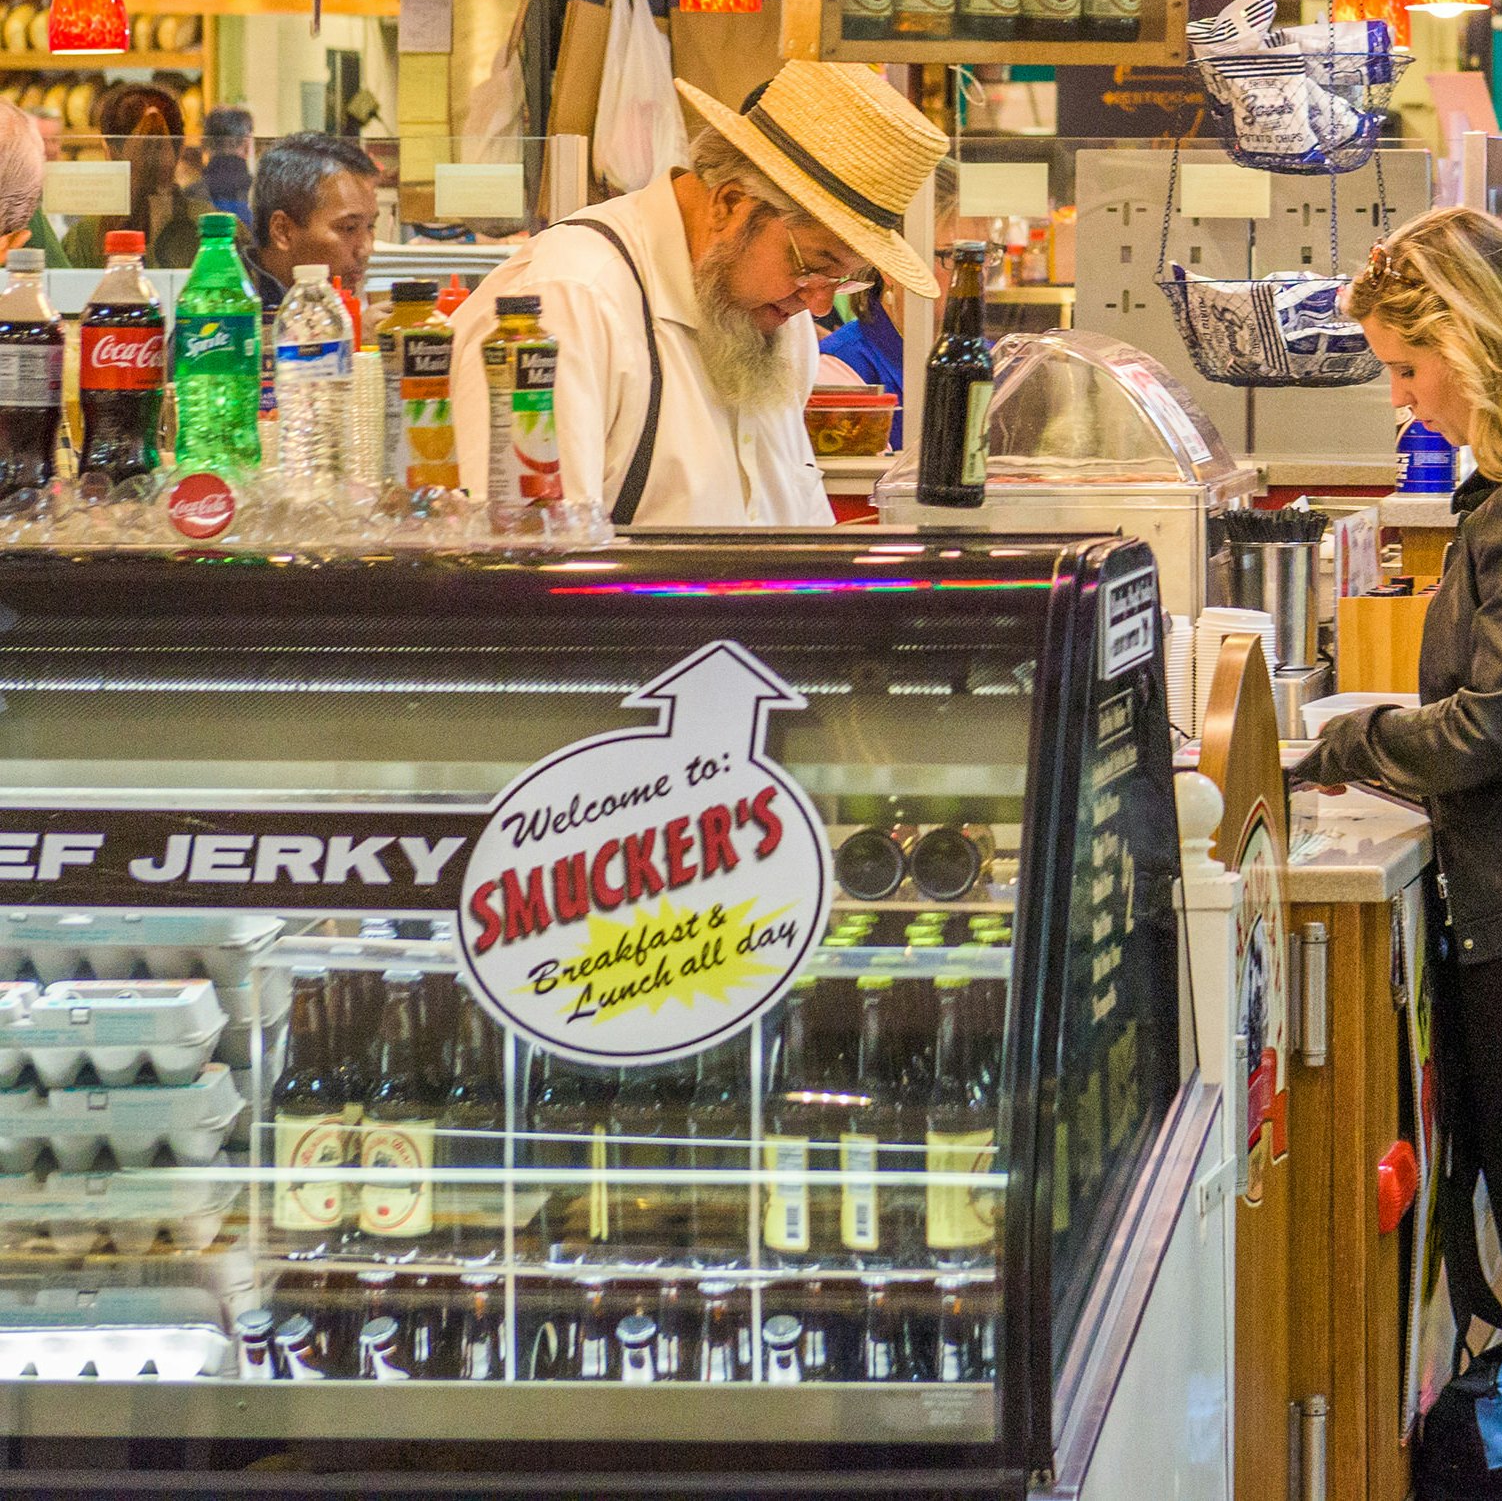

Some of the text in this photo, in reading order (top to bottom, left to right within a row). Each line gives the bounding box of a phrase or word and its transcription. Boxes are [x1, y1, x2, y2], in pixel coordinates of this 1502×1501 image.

[501, 752, 731, 849] Welcome to:
[128, 833, 467, 886] JERKY
[468, 785, 786, 958] SMUCKER'S
[526, 902, 728, 996] Breakfast &
[566, 918, 798, 1025] Lunch all day
